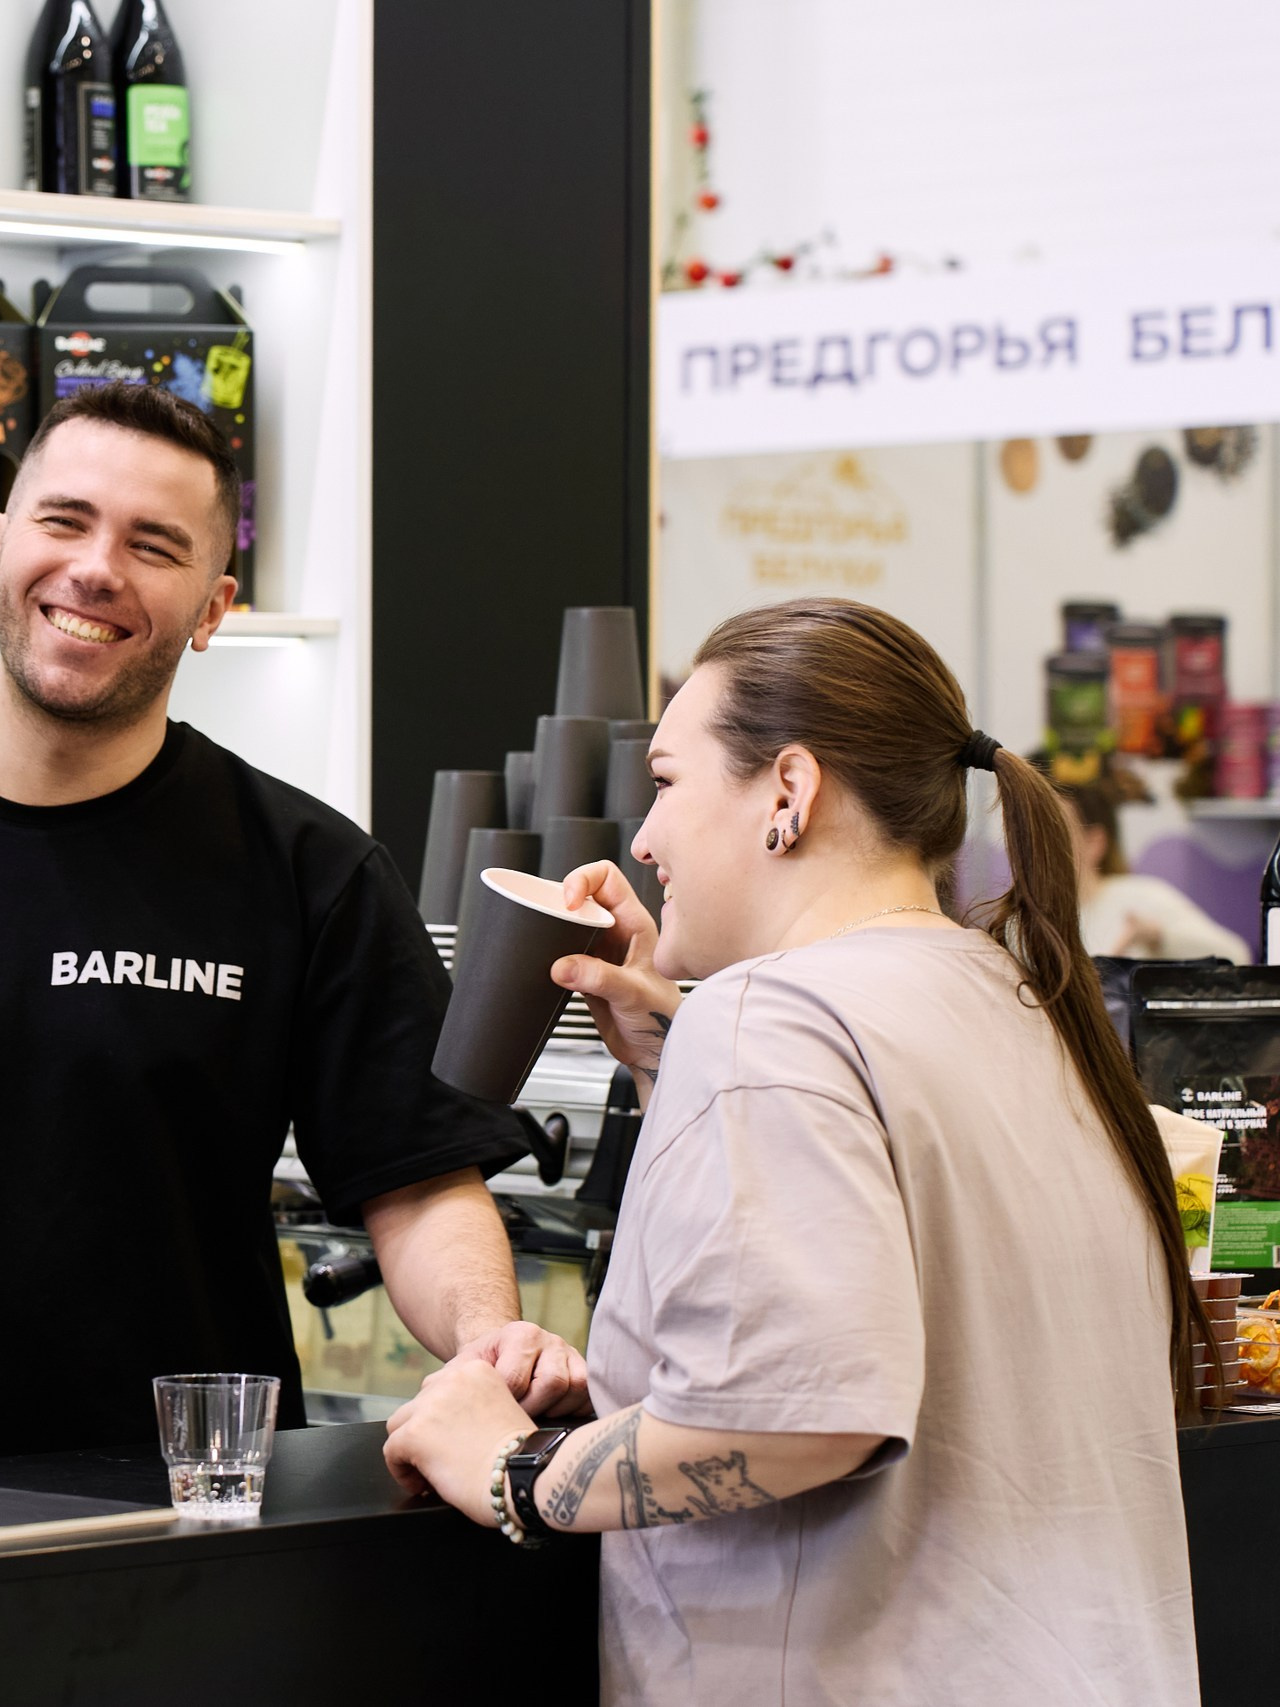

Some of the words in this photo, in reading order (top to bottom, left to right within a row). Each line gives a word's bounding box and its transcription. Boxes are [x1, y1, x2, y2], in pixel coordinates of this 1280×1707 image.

[680, 317, 1079, 395] ПРЕДГОРЬЯ
[1129, 302, 1276, 364] БЕЛ
[50, 949, 245, 1001] BARLINE
[1196, 1091, 1242, 1102] BARLINE
